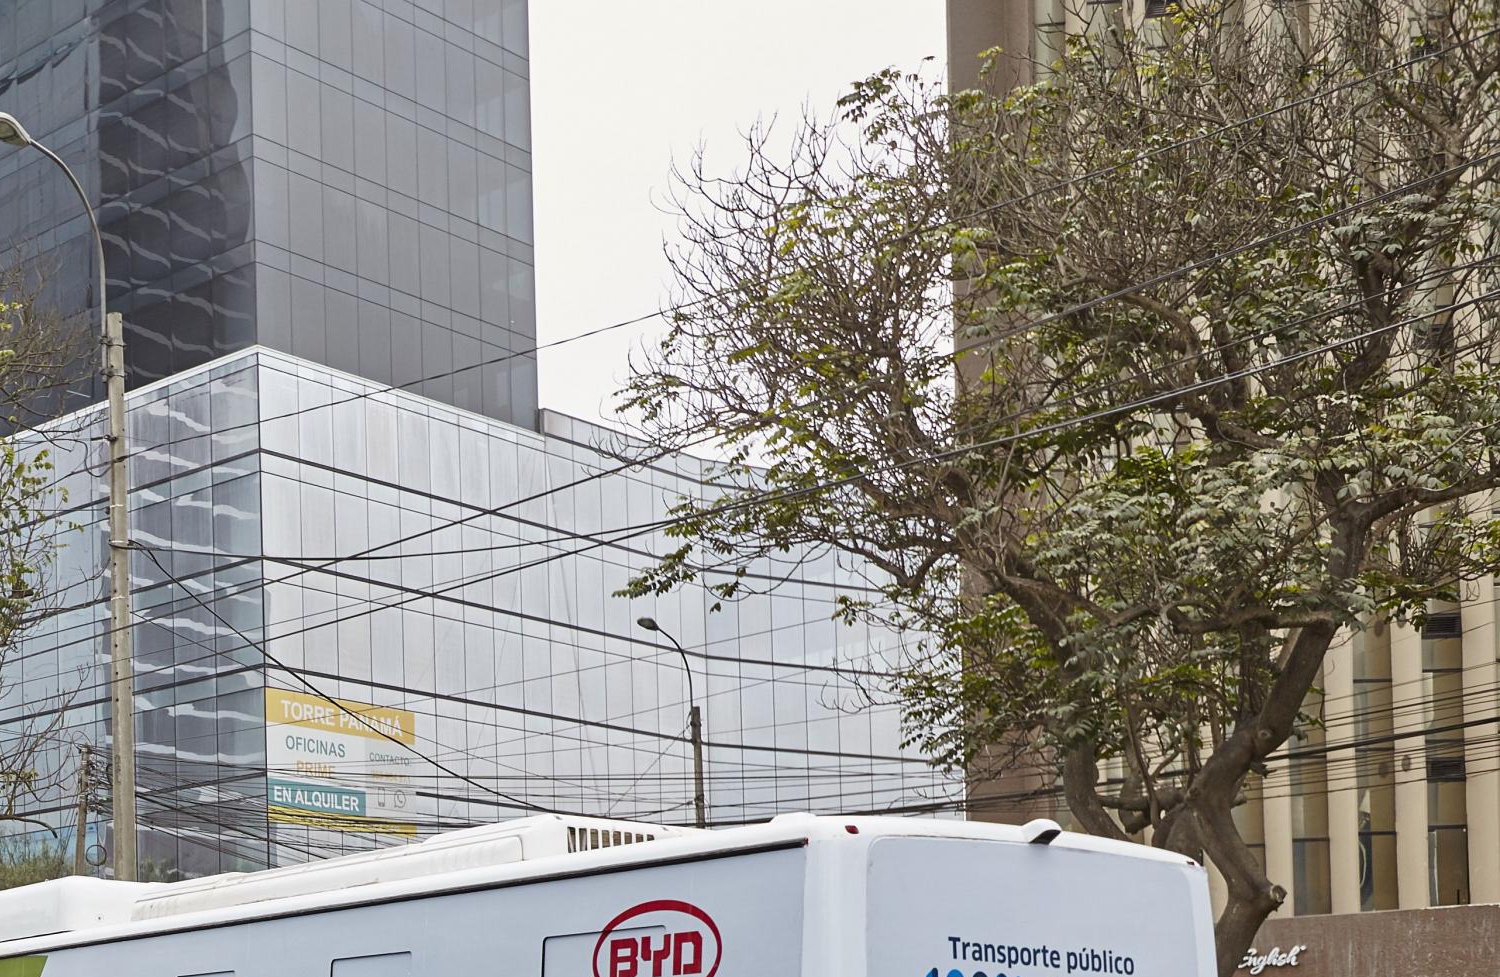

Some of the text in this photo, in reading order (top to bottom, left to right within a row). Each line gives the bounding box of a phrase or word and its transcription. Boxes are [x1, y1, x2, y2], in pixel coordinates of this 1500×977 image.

[280, 699, 403, 737] TORRE PANAMÁ
[285, 735, 346, 758] OFICINAS
[273, 786, 360, 812] EN ALQUILER
[948, 936, 1135, 975] Transporte público
